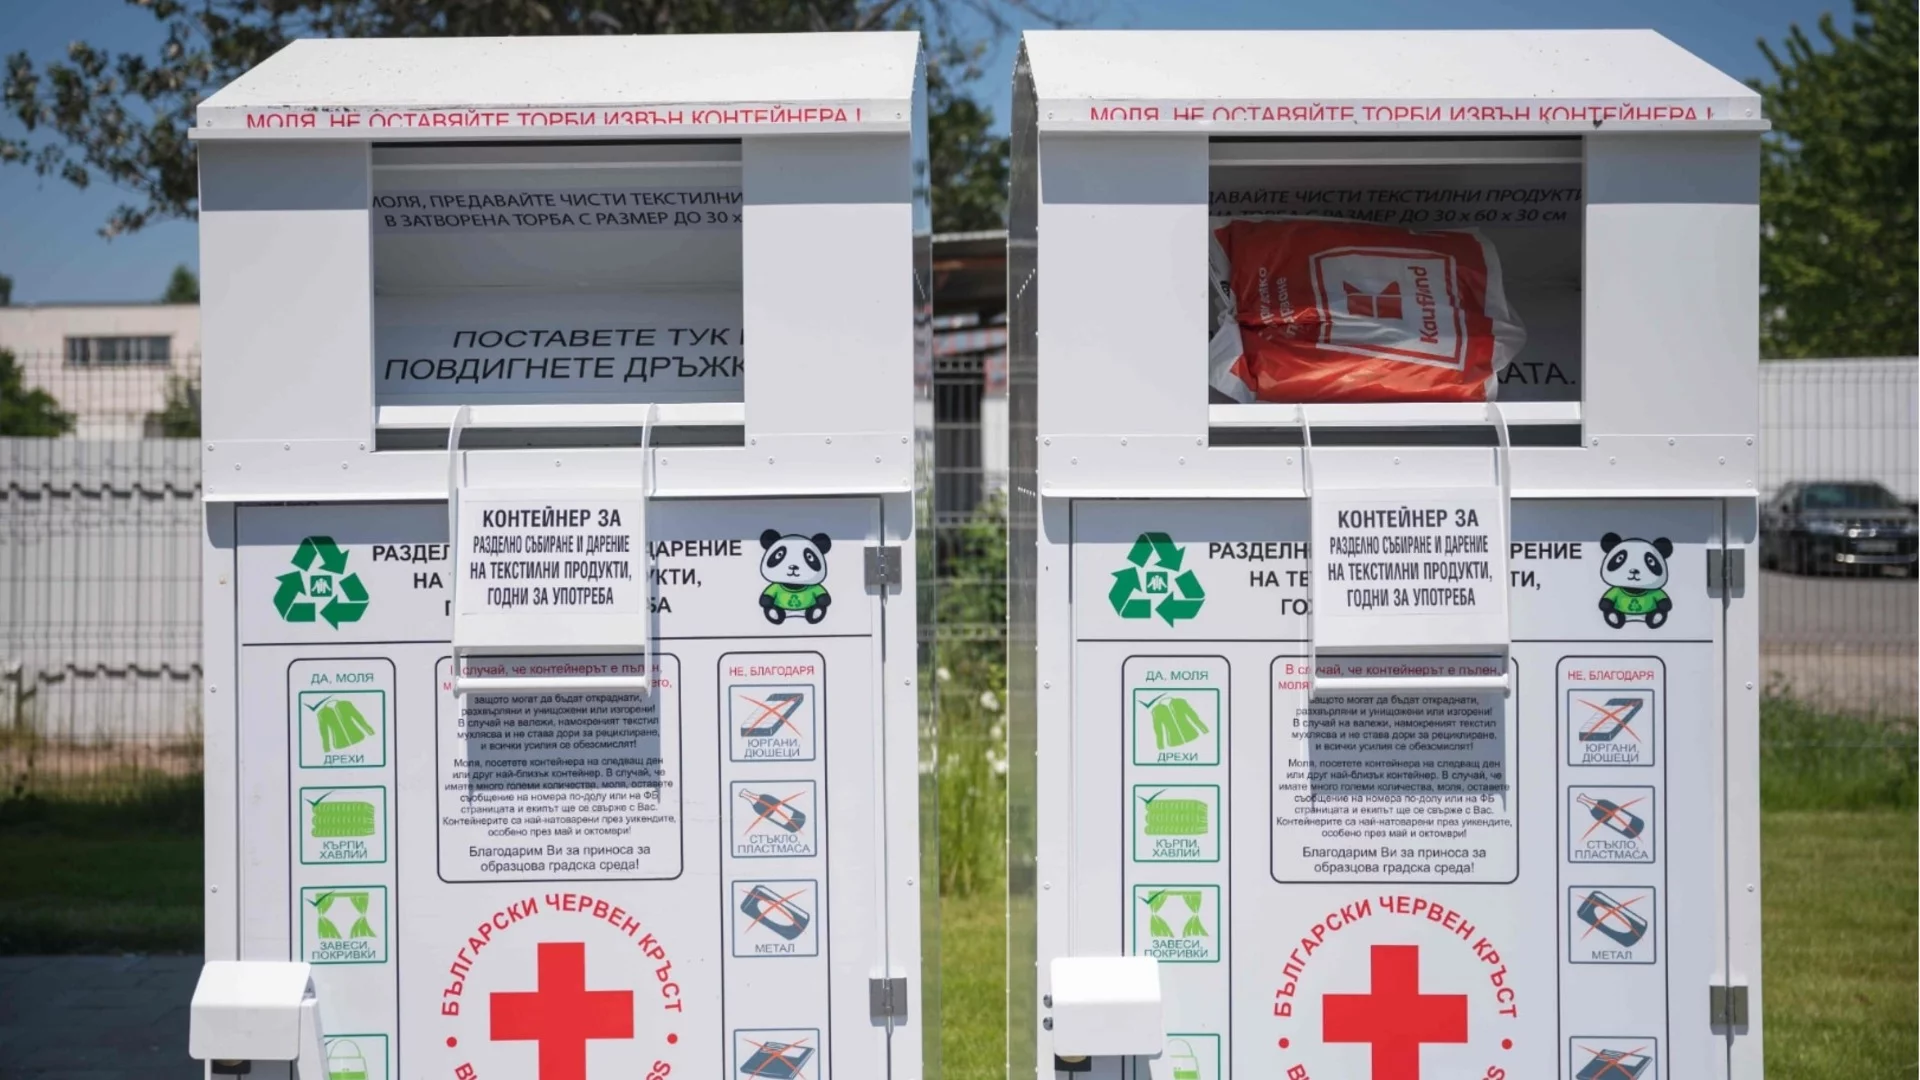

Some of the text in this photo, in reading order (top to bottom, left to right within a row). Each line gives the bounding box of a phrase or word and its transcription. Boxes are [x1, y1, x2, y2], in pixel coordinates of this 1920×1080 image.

[330, 113, 360, 128] НЕ
[369, 108, 510, 128] ОСТАВЯЙТЕ
[517, 112, 596, 127] ТОРБИ
[604, 110, 684, 126] ИЗВЪН
[692, 105, 848, 124] КОНТЕЙНЕРА
[1174, 107, 1204, 120] НЕ
[1212, 103, 1354, 120] ОСТАВЯЙТЕ
[1363, 106, 1441, 120] ТОРБИ
[1450, 106, 1530, 120] ИЗВЪН
[1540, 102, 1698, 120] КОНТЕЙНЕРА
[432, 191, 555, 210] ПРЕДАВАЙТЕ
[560, 192, 627, 206] ЧИСТИ
[630, 191, 743, 206] ТЕКСТИЛНИ
[1296, 188, 1362, 204] ЧИСТИ
[1366, 188, 1482, 204] ТЕКСТИЛНИ
[385, 214, 398, 227] В
[402, 213, 510, 227] ЗАТВОРЕНА
[513, 212, 575, 226] ТОРБА
[579, 212, 592, 226] С
[596, 211, 668, 225] РАЗМЕР
[674, 211, 702, 226] ДО
[707, 211, 729, 224] 30
[1399, 208, 1428, 225] ДО
[1434, 208, 1456, 222] 30
[1475, 208, 1498, 222] 60
[1518, 208, 1540, 222] 30
[1543, 210, 1567, 222] см
[452, 329, 656, 348] ПОСТАВЕТЕ
[667, 328, 731, 346] ТУК
[384, 356, 615, 384] ПОВДИГНЕТЕ
[483, 506, 622, 528] КОНТЕЙНЕР ЗА
[1338, 506, 1480, 528] КОНТЕЙНЕР ЗА
[473, 534, 630, 557] РАЗДЕЛНО СЪБИРАНЕ И ДАРЕНИЕ
[1330, 535, 1488, 558] РАЗДЕЛНО СЪБИРАНЕ И ДАРЕНИЕ
[470, 560, 632, 582] НА ТЕКСТИЛНИ ПРОДУКТИ,
[1328, 562, 1345, 581] НА
[1348, 562, 1419, 581] ТЕКСТИЛНИ
[1424, 561, 1493, 582] ПРОДУКТИ,
[414, 572, 444, 589] НА
[1250, 570, 1280, 587] НА
[487, 586, 614, 608] ГОДНИ ЗА УПОТРЕБА
[1347, 587, 1476, 610] ГОДНИ ЗА УПОТРЕБА
[512, 666, 526, 674] че
[530, 662, 606, 674] контейнерът
[622, 664, 663, 675] пълн,
[730, 666, 815, 677] НЕ, БЛАГОДАРЯ
[1348, 666, 1362, 674] че
[1366, 663, 1444, 675] контейнерът
[310, 673, 374, 685] ДА, МОЛЯ
[1146, 670, 1208, 682] ДА, МОЛЯ
[1568, 670, 1654, 682] НЕ, БЛАГОДАРЯ
[748, 738, 800, 748] ЮРГАНИ,
[1586, 744, 1640, 754] ЮРГАНИ,
[744, 748, 800, 758] ДЮШЕЦИ
[1157, 752, 1198, 762] ДРЕХИ
[1582, 753, 1640, 764] ДЮШЕЦИ
[323, 755, 364, 765] ДРЕХИ
[488, 828, 528, 838] особено
[554, 826, 573, 836] май
[750, 834, 800, 844] СТЪКЛО,
[1156, 839, 1200, 849] КЪРПИ,
[1586, 840, 1639, 850] СТЪКЛО,
[322, 840, 366, 851] КЪРПИ,
[468, 844, 651, 858] Благодарим Ви за приноса за
[738, 844, 810, 854] ПЛАСТМАСА
[320, 850, 368, 860] ХАВЛИИ
[1152, 848, 1200, 858] ХАВЛИИ
[1302, 846, 1486, 860] Благодарим Ви за приноса за
[1574, 850, 1648, 860] ПЛАСТМАСА
[480, 859, 640, 874] образцова градска среда!
[1314, 862, 1474, 875] образцова градска среда!
[320, 940, 370, 950] ЗАВЕСИ,
[755, 944, 796, 954] МЕТАЛ
[1152, 940, 1202, 950] ЗАВЕСИ,
[312, 950, 376, 960] ПОКРИВКИ
[442, 894, 682, 1016] БЪЛГАРСКИ ЧЕРВЕН КРЪСТ
[1144, 949, 1208, 958] ПОКРИВКИ
[1274, 896, 1518, 1018] БЪЛГАРСКИ ЧЕРВЕН КРЪСТ
[1592, 950, 1633, 960] МЕТАЛ
